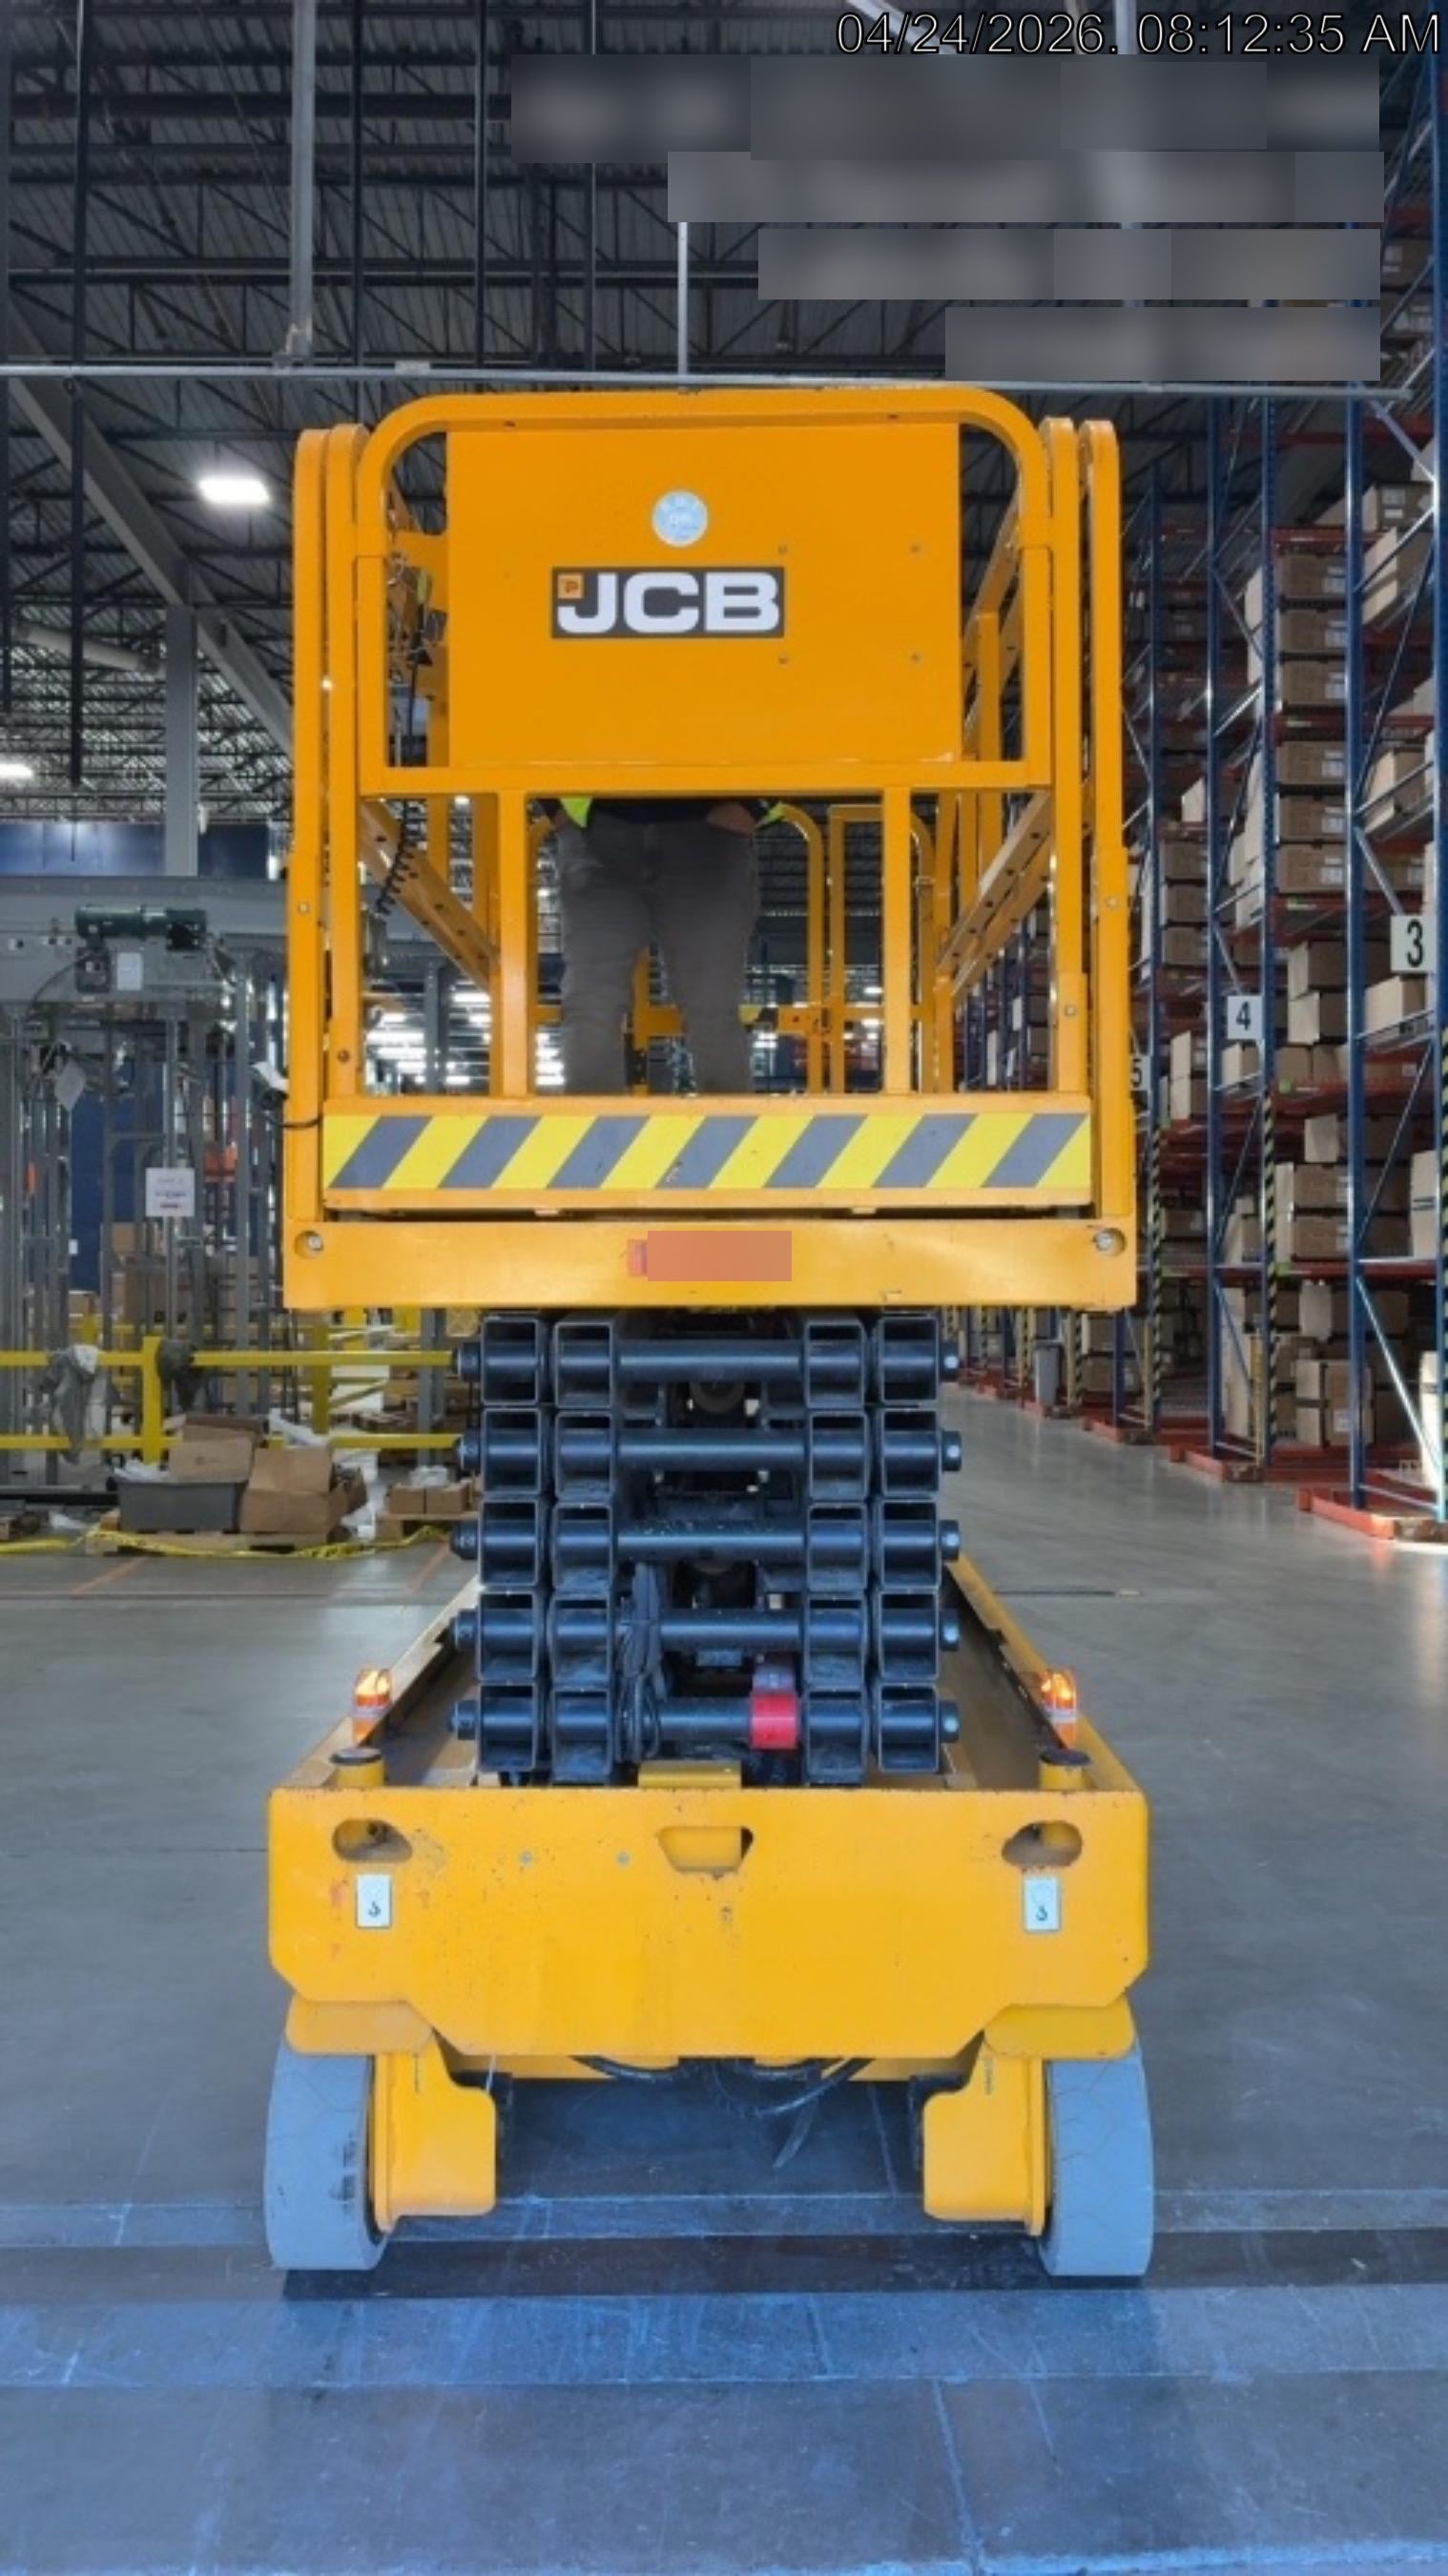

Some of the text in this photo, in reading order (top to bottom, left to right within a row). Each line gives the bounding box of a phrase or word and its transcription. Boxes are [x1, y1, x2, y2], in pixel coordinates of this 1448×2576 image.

[557, 572, 780, 634] JCB
[1407, 919, 1423, 967] 3
[1235, 1001, 1251, 1030] 4
